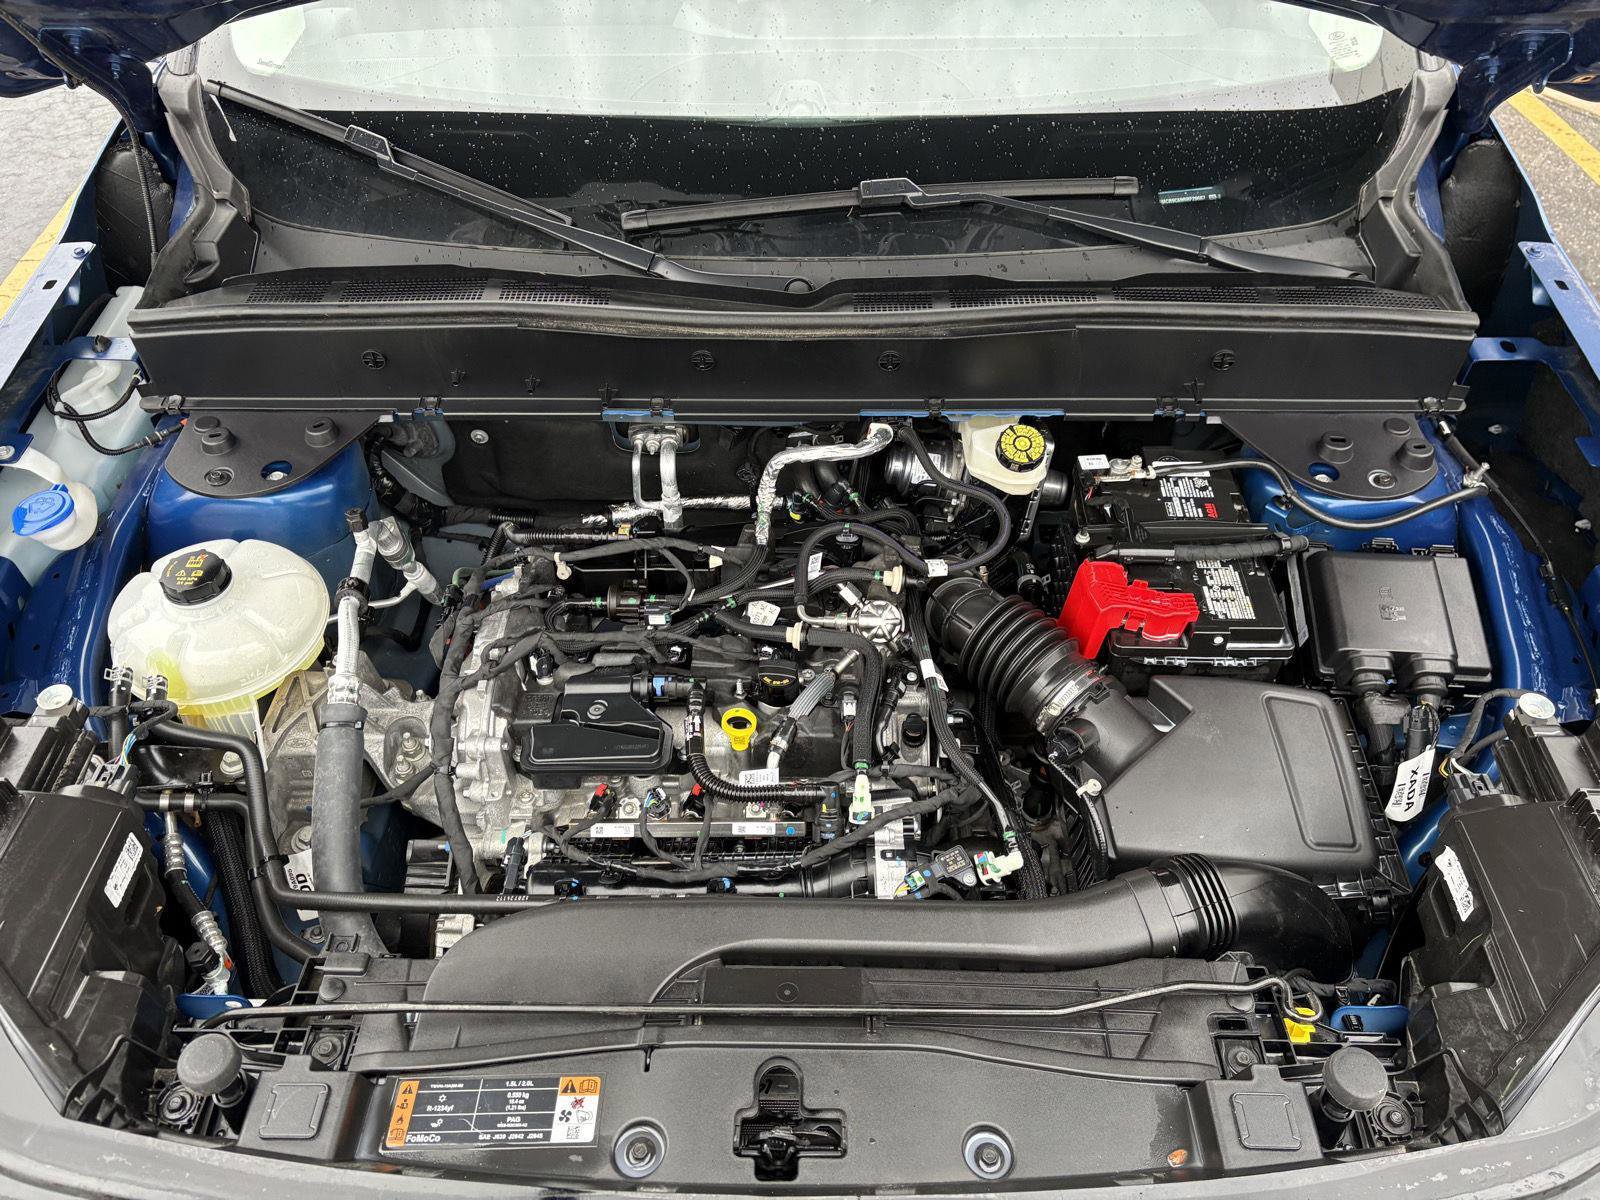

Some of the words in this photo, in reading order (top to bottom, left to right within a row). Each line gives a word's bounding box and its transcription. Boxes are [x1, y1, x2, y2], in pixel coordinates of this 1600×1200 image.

[1404, 766, 1420, 812] XADA
[426, 1105, 454, 1113] R-1234yf
[405, 1134, 441, 1143] FoMoCo
